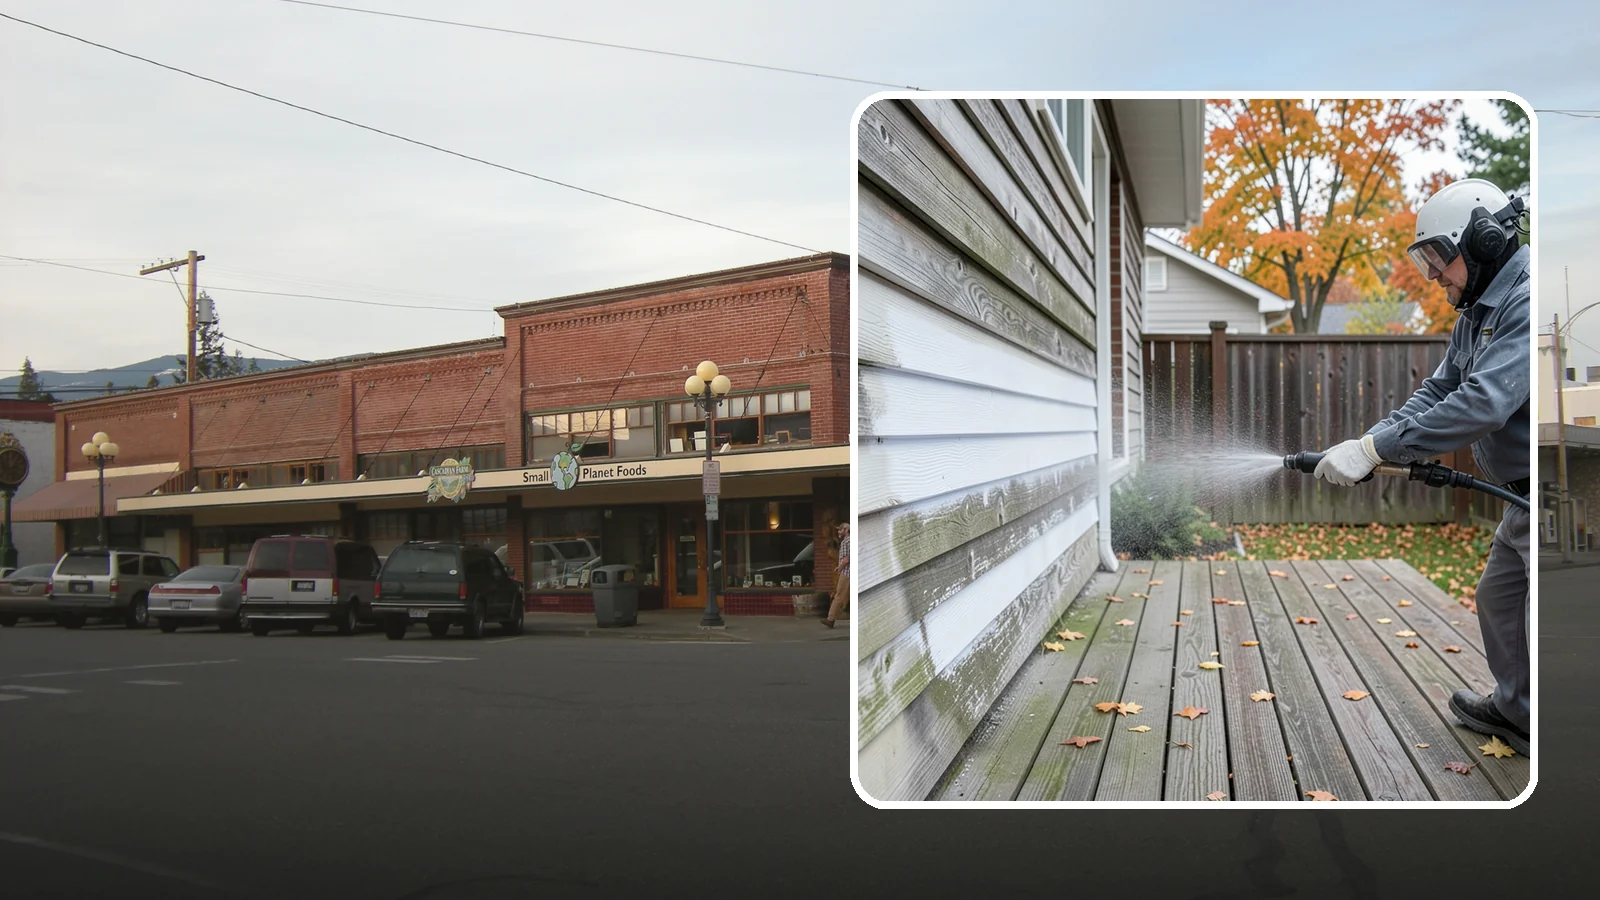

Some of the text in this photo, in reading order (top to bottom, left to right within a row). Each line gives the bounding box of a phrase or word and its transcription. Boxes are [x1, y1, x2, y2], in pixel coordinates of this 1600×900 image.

[523, 464, 647, 483] Small Planet Foods
